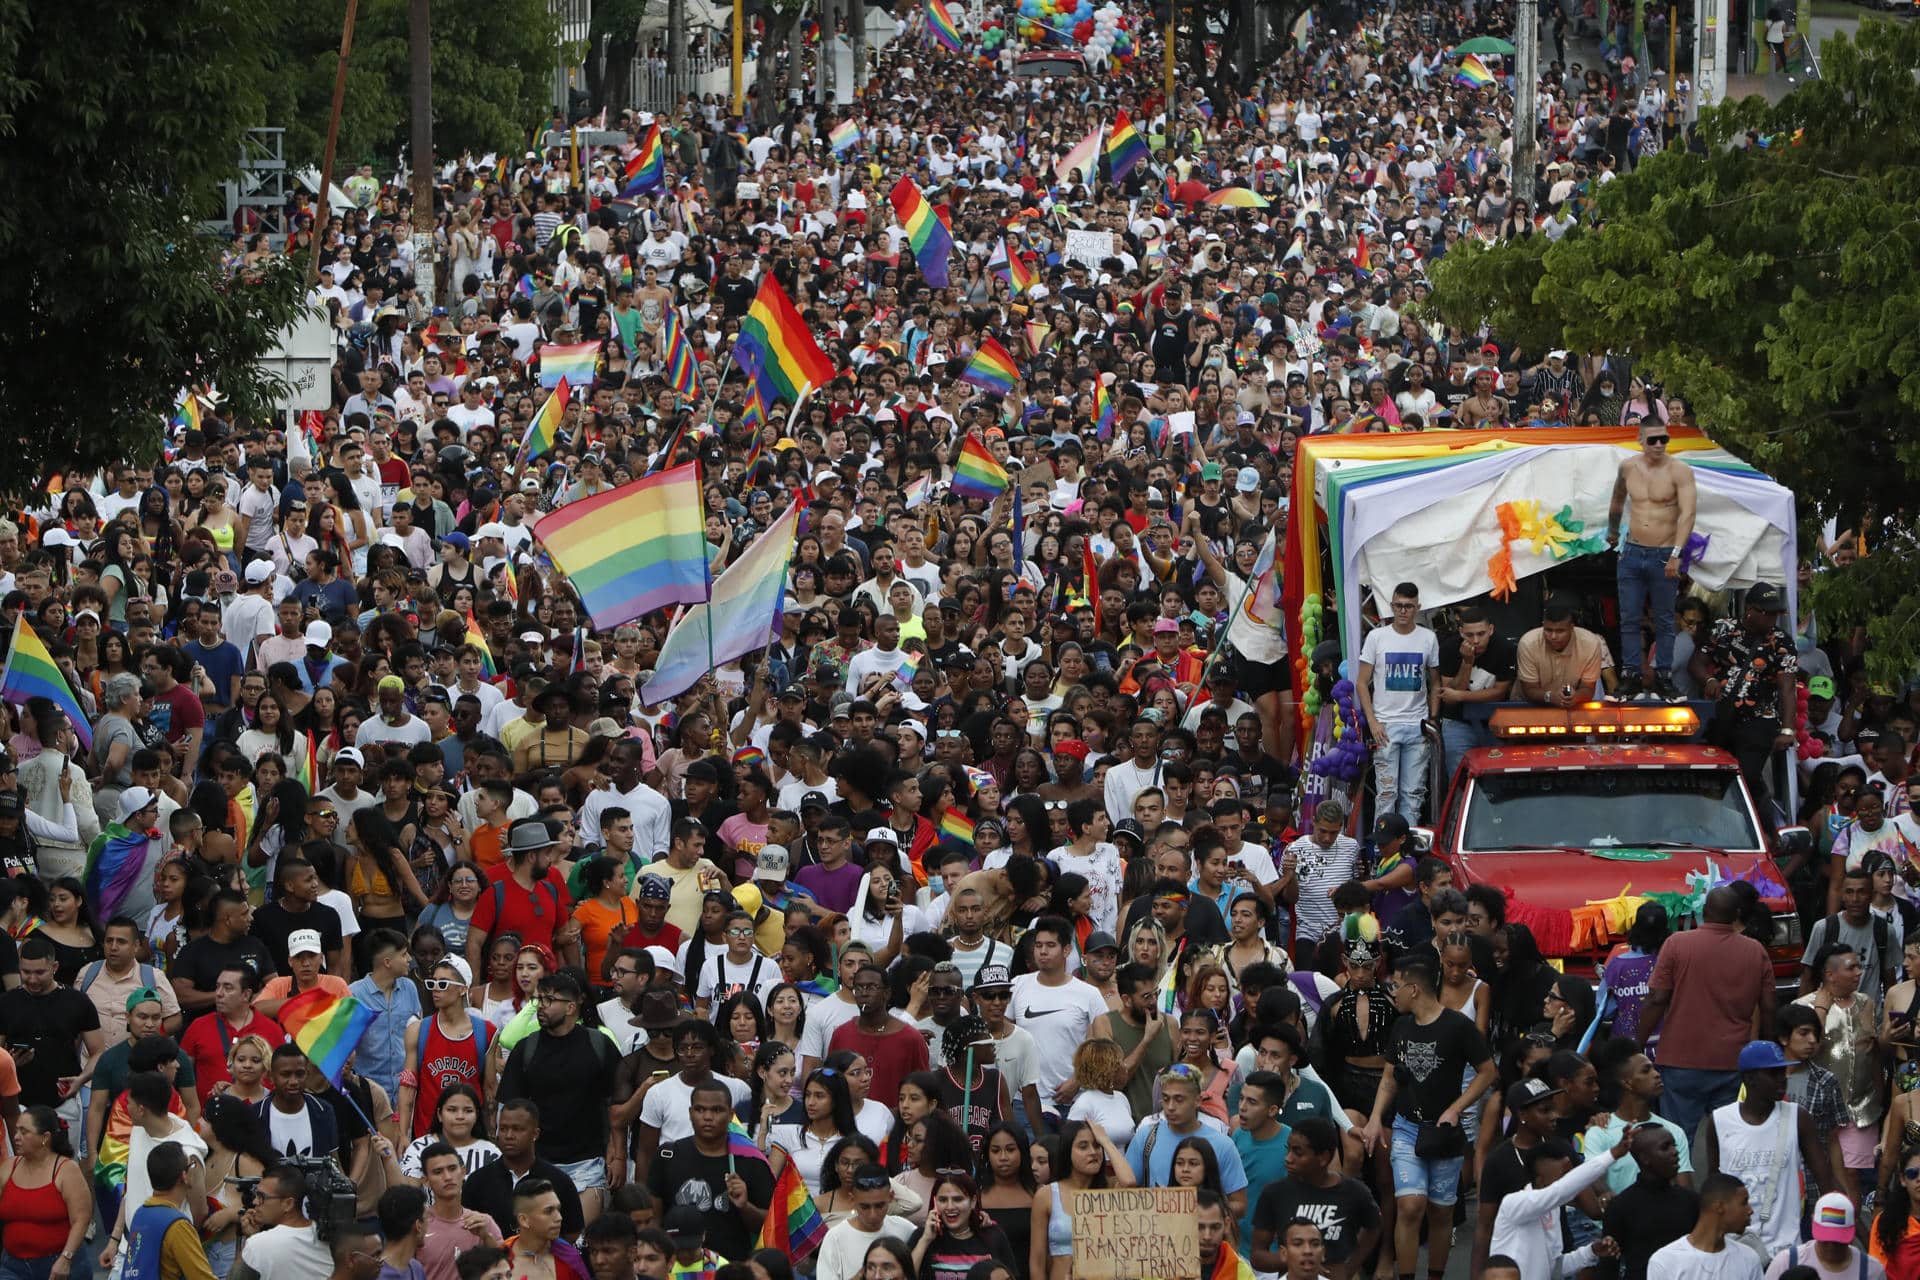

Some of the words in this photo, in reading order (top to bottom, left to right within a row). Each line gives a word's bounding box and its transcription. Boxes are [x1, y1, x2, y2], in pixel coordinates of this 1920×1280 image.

[1384, 663, 1425, 679] WAVES
[427, 1056, 477, 1079] JORDAN
[1075, 1190, 1154, 1216] COMUNIDAD
[1074, 1217, 1091, 1237] LA
[1094, 1214, 1108, 1236] T
[1113, 1214, 1134, 1236] ES
[1139, 1214, 1161, 1237] DE
[1296, 1204, 1338, 1226] NIKE
[1324, 1225, 1342, 1240] SB
[1072, 1235, 1177, 1261] TRANSFOBIA
